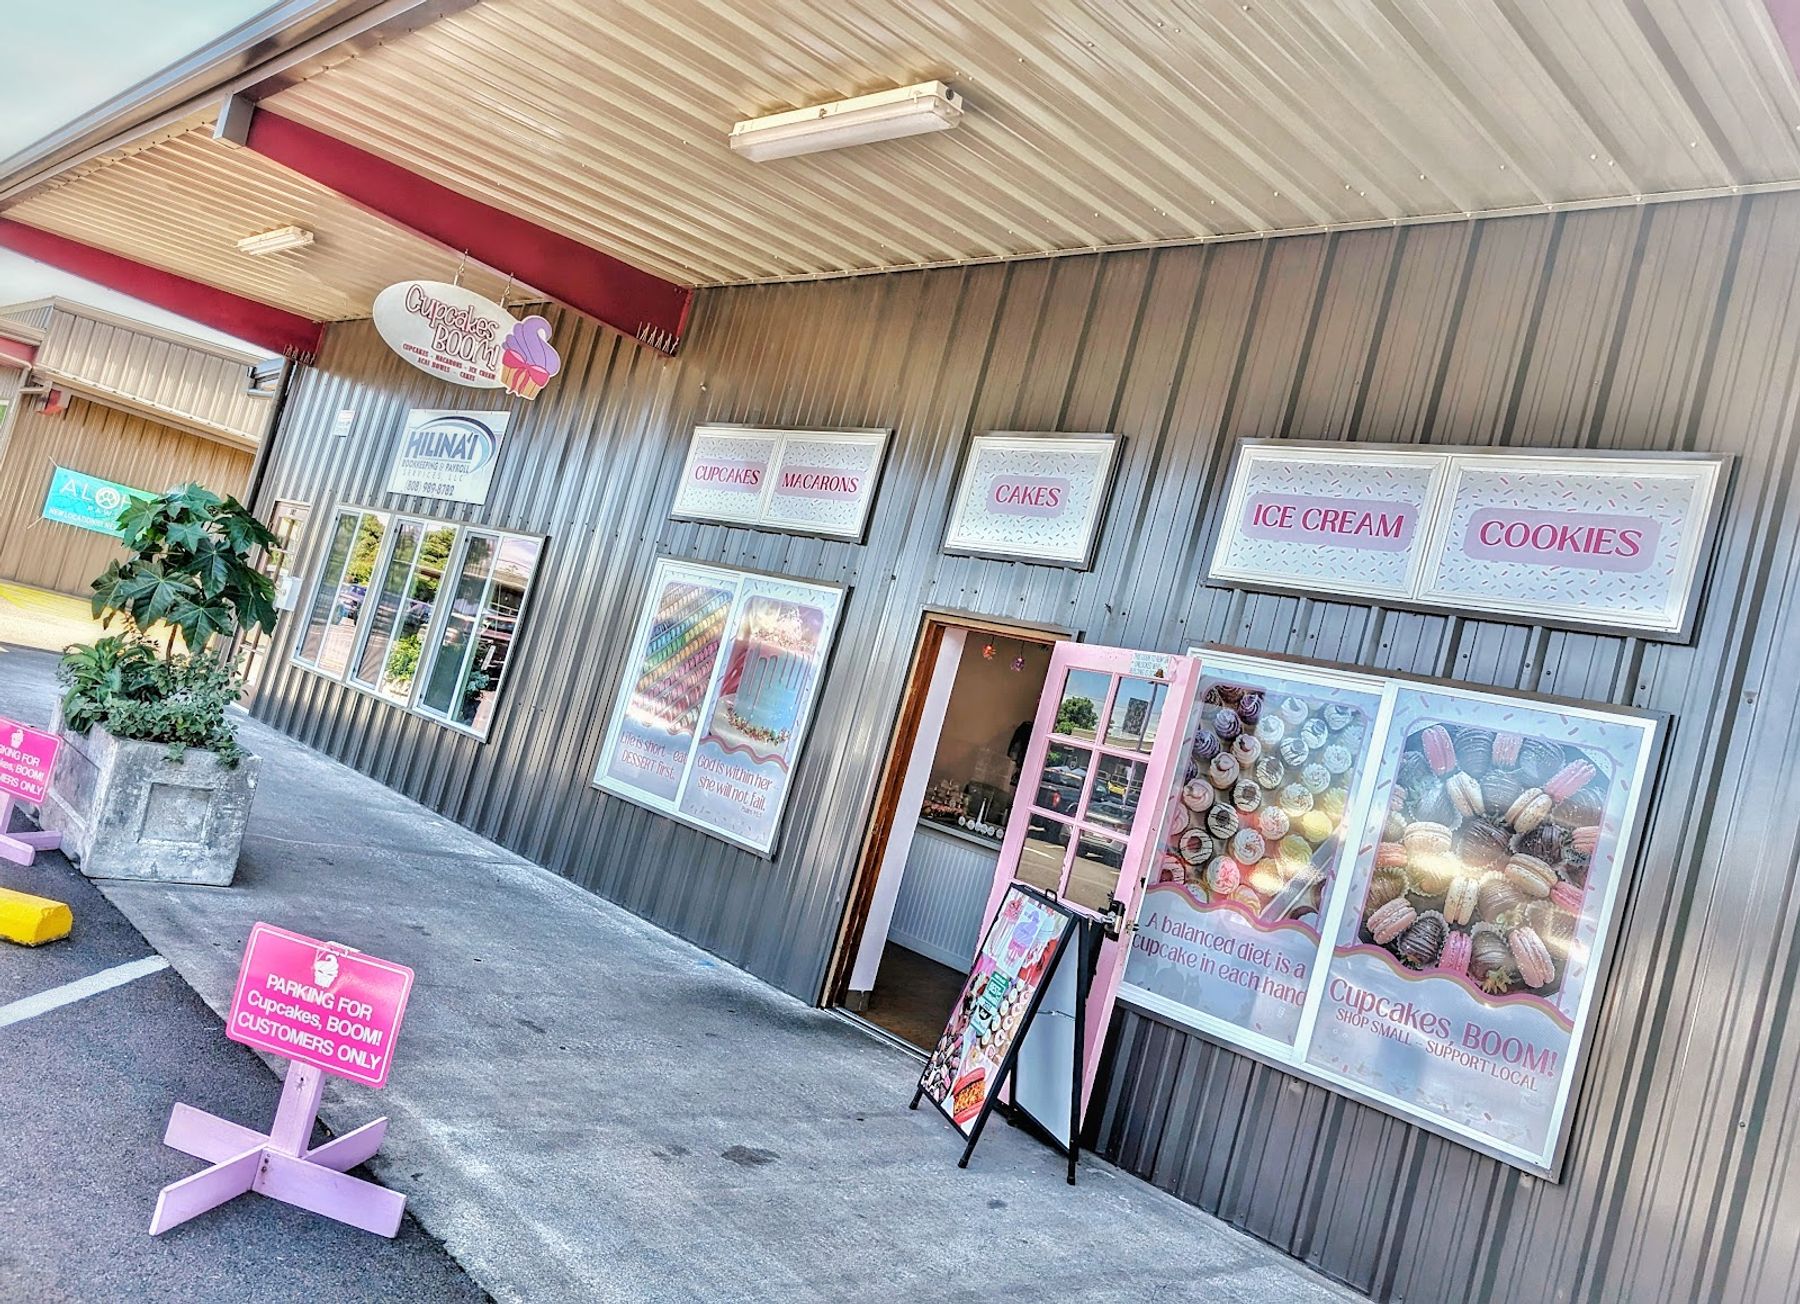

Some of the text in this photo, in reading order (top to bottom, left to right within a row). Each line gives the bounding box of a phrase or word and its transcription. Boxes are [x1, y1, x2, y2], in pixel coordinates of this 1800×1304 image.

[405, 284, 500, 371] Cupcakes BOOM!
[402, 343, 429, 358] CUPCAKES
[436, 355, 462, 368] MACARONS
[479, 370, 496, 380] CREAM
[432, 362, 450, 373] BOWLS
[460, 371, 476, 382] CAKES
[445, 463, 470, 474] PAYROLL
[694, 464, 760, 486] CUPCAKES
[782, 472, 860, 493] MACARONS
[995, 483, 1061, 508] CAKES
[1253, 503, 1406, 539] ICE CREAM
[1478, 519, 1642, 558] COOKIES
[22, 752, 40, 768] FOR
[622, 749, 676, 780] DESSERT first.
[644, 740, 666, 758] short
[20, 780, 44, 796] ONLY
[697, 754, 773, 791] God is within her
[698, 775, 716, 790] she
[716, 780, 732, 798] will
[732, 787, 749, 804] not
[750, 792, 766, 812] fail.
[1132, 932, 1198, 968] cupcake
[1200, 953, 1216, 976] in
[1218, 963, 1260, 990] each
[1145, 912, 1306, 980] A balanced diet is a
[266, 974, 373, 1021] PARKING FOR
[248, 990, 384, 1046] Cupcakes, BOOM!
[1329, 977, 1558, 1078] Cupcakes, BOOM!
[238, 1011, 382, 1070] CUSTOMERS ONLY
[1336, 1008, 1370, 1029] SHOP
[1370, 1020, 1412, 1046] SMALL
[1425, 1040, 1491, 1073] SUPPORT
[1491, 1066, 1538, 1092] LOCAL
